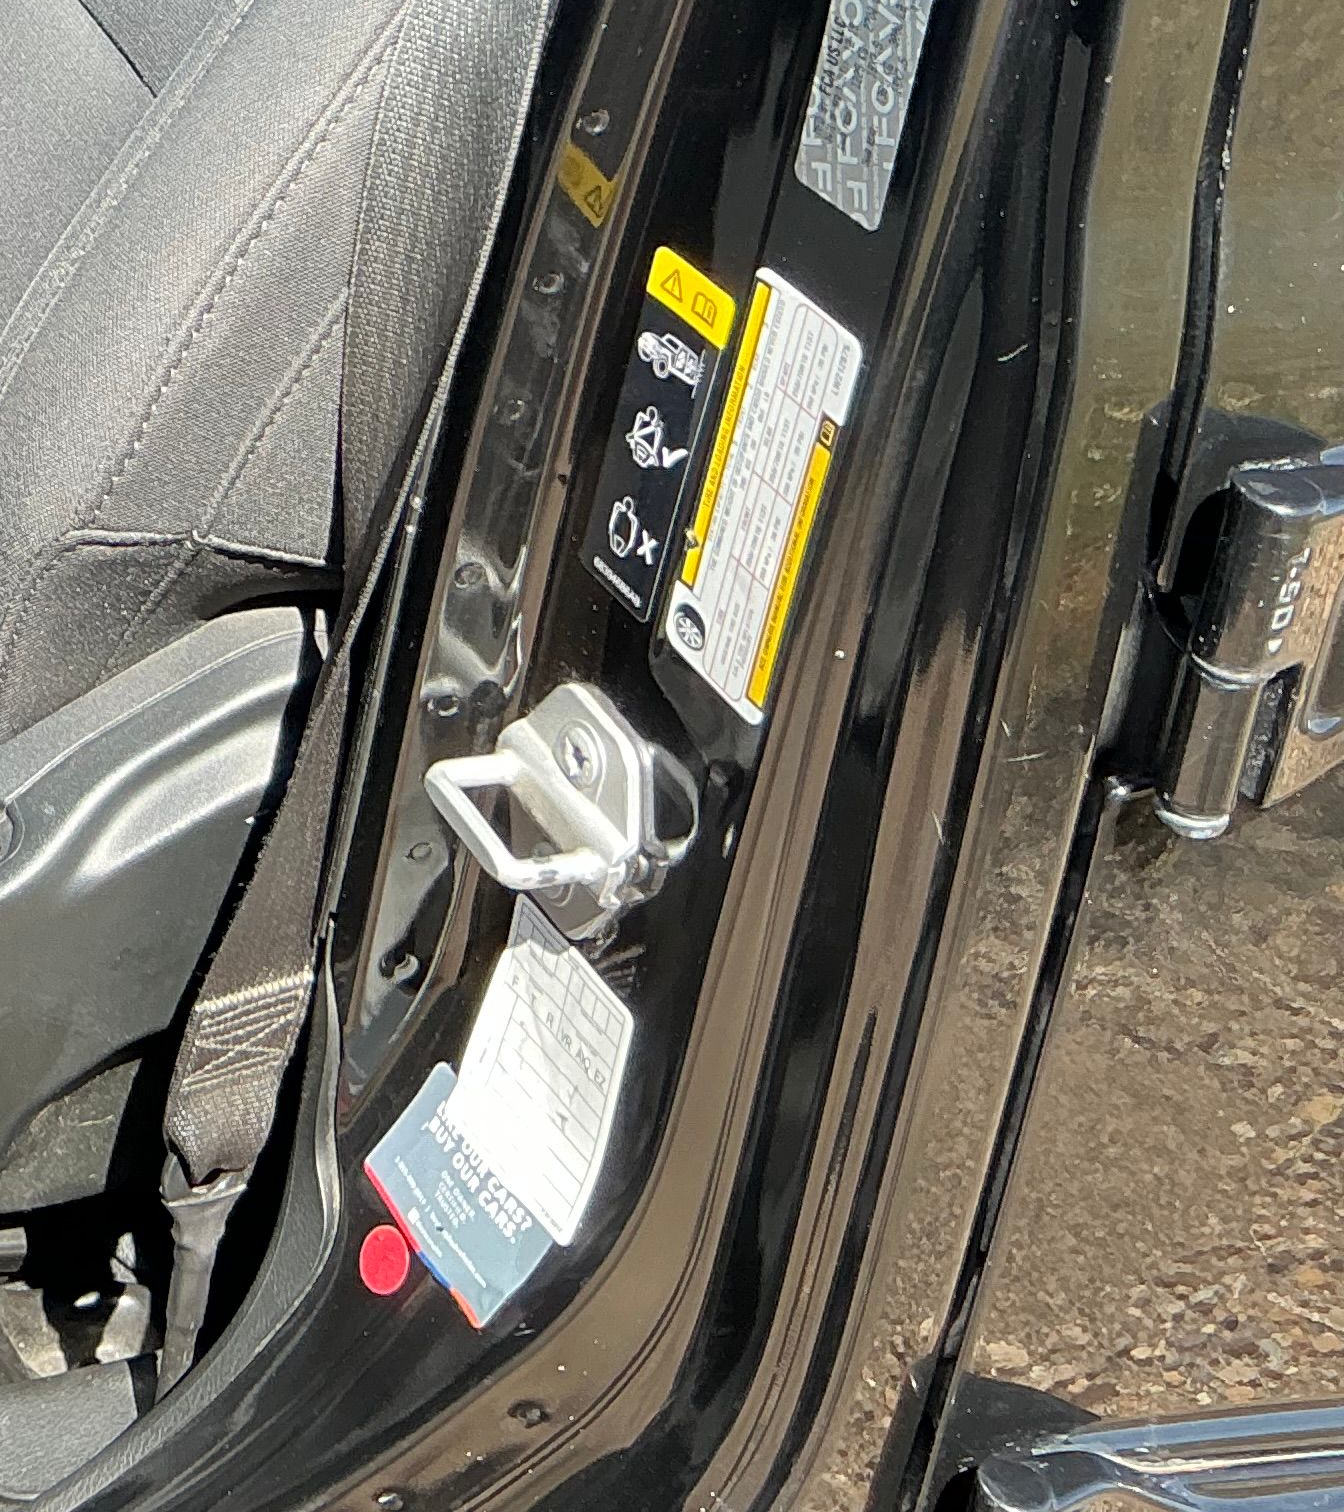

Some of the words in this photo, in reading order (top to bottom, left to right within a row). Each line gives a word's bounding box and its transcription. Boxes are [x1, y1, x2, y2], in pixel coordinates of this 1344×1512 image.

[832, 15, 847, 46] LLC
[827, 44, 840, 68] US
[819, 68, 836, 97] FCA
[428, 1115, 456, 1152] BUY
[452, 1151, 480, 1193] OUR
[478, 1190, 517, 1244] CARS.
[462, 1138, 486, 1179] OUR
[487, 1176, 533, 1232] CARS?
